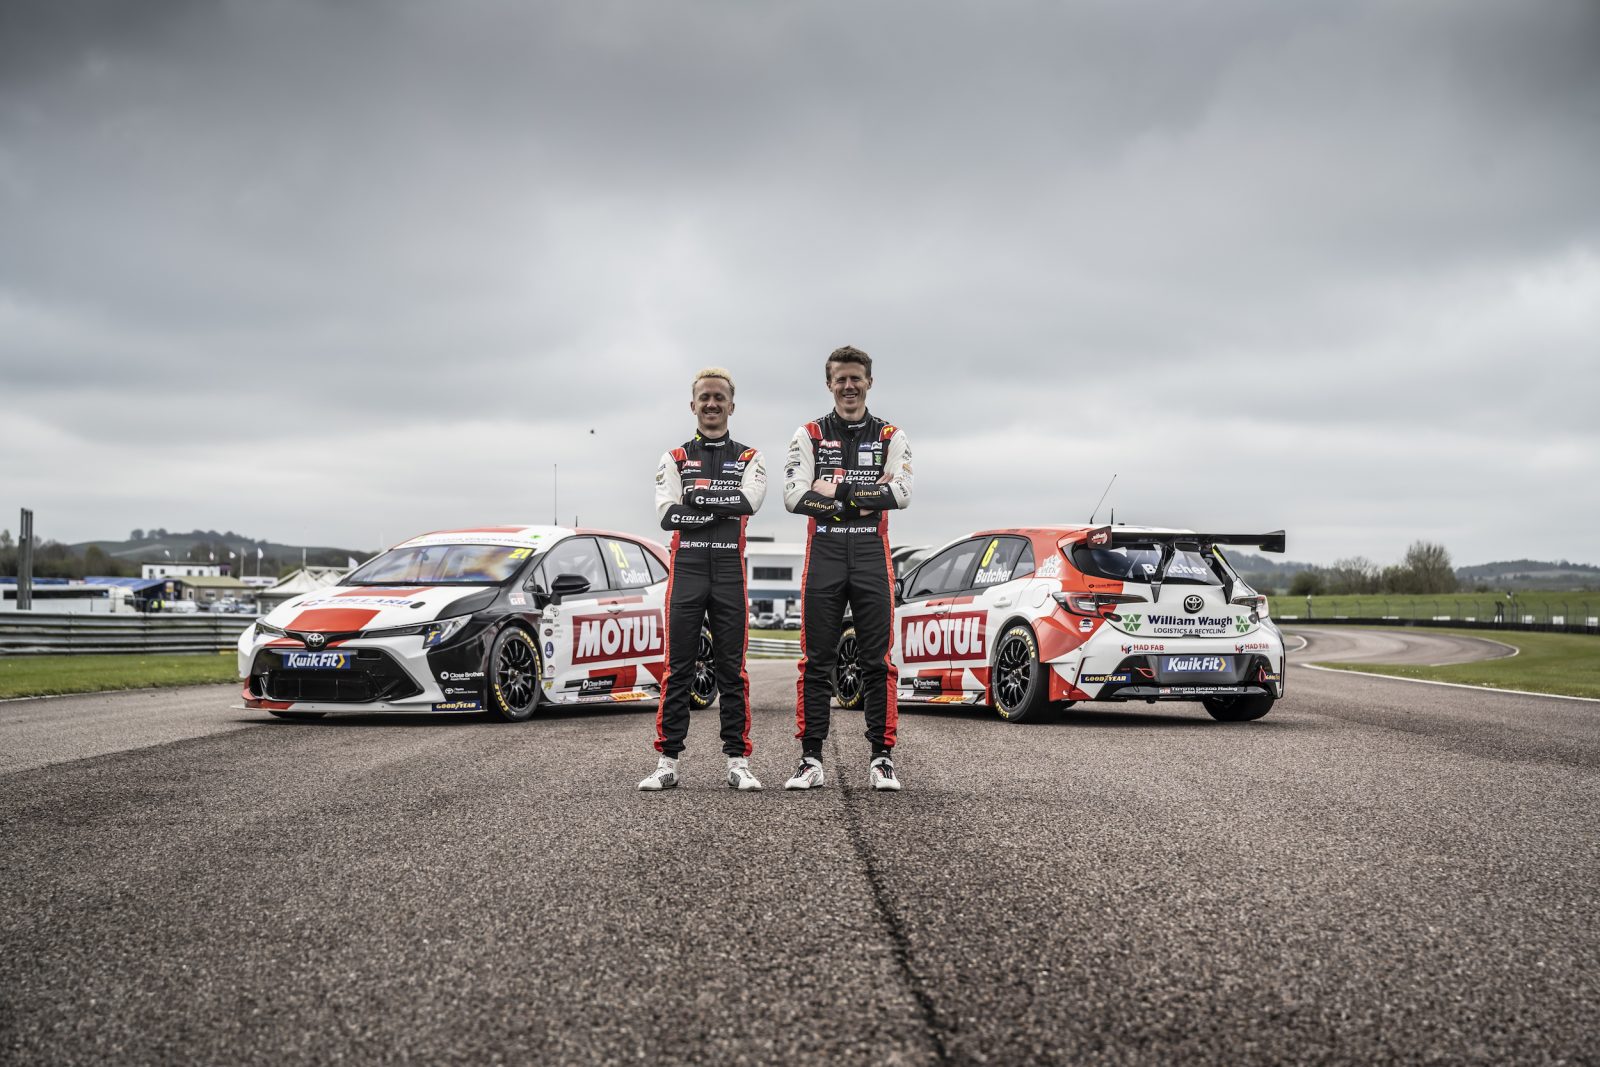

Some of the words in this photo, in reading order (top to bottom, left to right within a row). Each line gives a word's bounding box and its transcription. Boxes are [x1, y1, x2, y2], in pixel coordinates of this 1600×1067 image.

[830, 526, 849, 534] RORY
[508, 548, 533, 560] 21
[608, 542, 629, 569] 21
[981, 539, 999, 568] 6
[620, 569, 652, 584] Collard
[974, 567, 1012, 584] Butcher
[1147, 615, 1195, 626] William
[1198, 616, 1233, 628] Waugh
[576, 615, 662, 658] MOTUL
[905, 617, 983, 658] MOTUL
[1153, 627, 1188, 635] LOGISTICS
